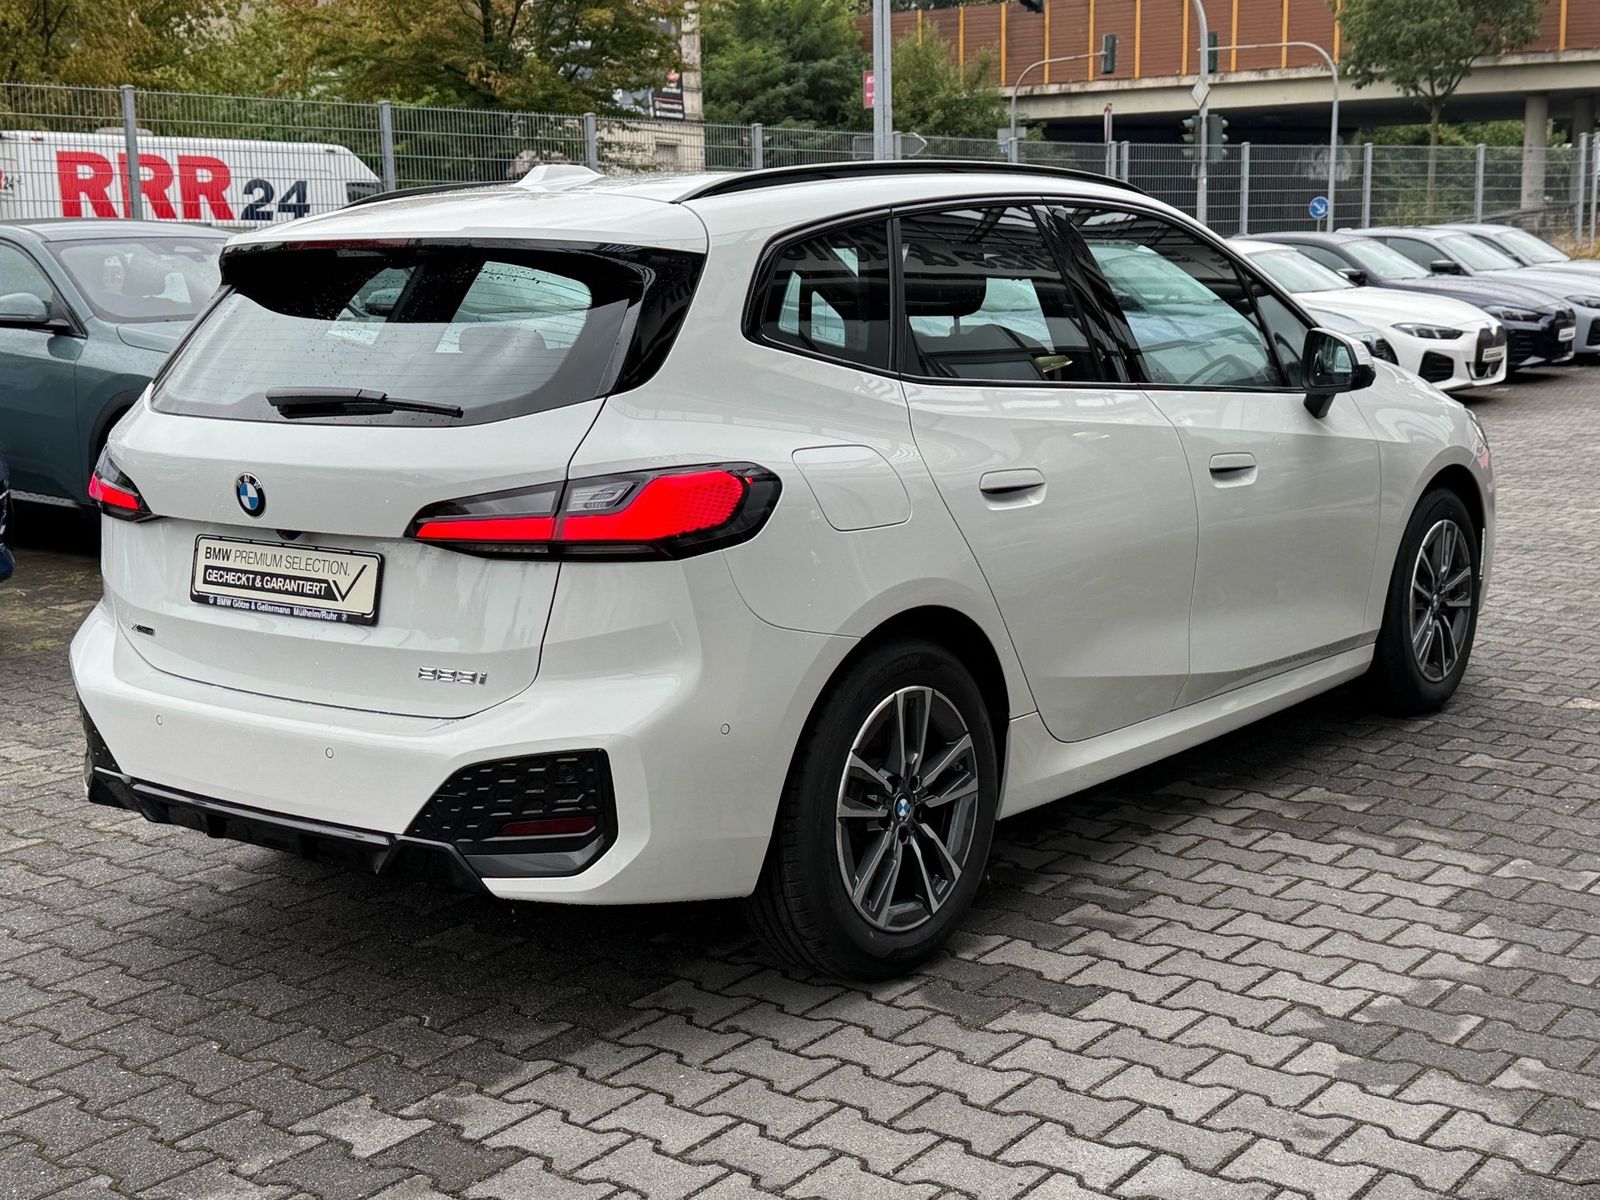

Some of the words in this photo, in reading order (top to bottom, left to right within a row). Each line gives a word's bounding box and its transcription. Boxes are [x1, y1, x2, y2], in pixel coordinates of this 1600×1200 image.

[56, 150, 235, 220] RRR
[241, 178, 311, 221] 24
[204, 546, 232, 562] BMW
[234, 549, 283, 568] PREMIUM
[206, 569, 254, 587] GECHECKT
[254, 576, 262, 588] &
[263, 577, 327, 595] GARANTIERT
[216, 597, 231, 606] BMW
[232, 599, 250, 609] Götze
[250, 601, 256, 610] &
[256, 602, 291, 615] Gellermann
